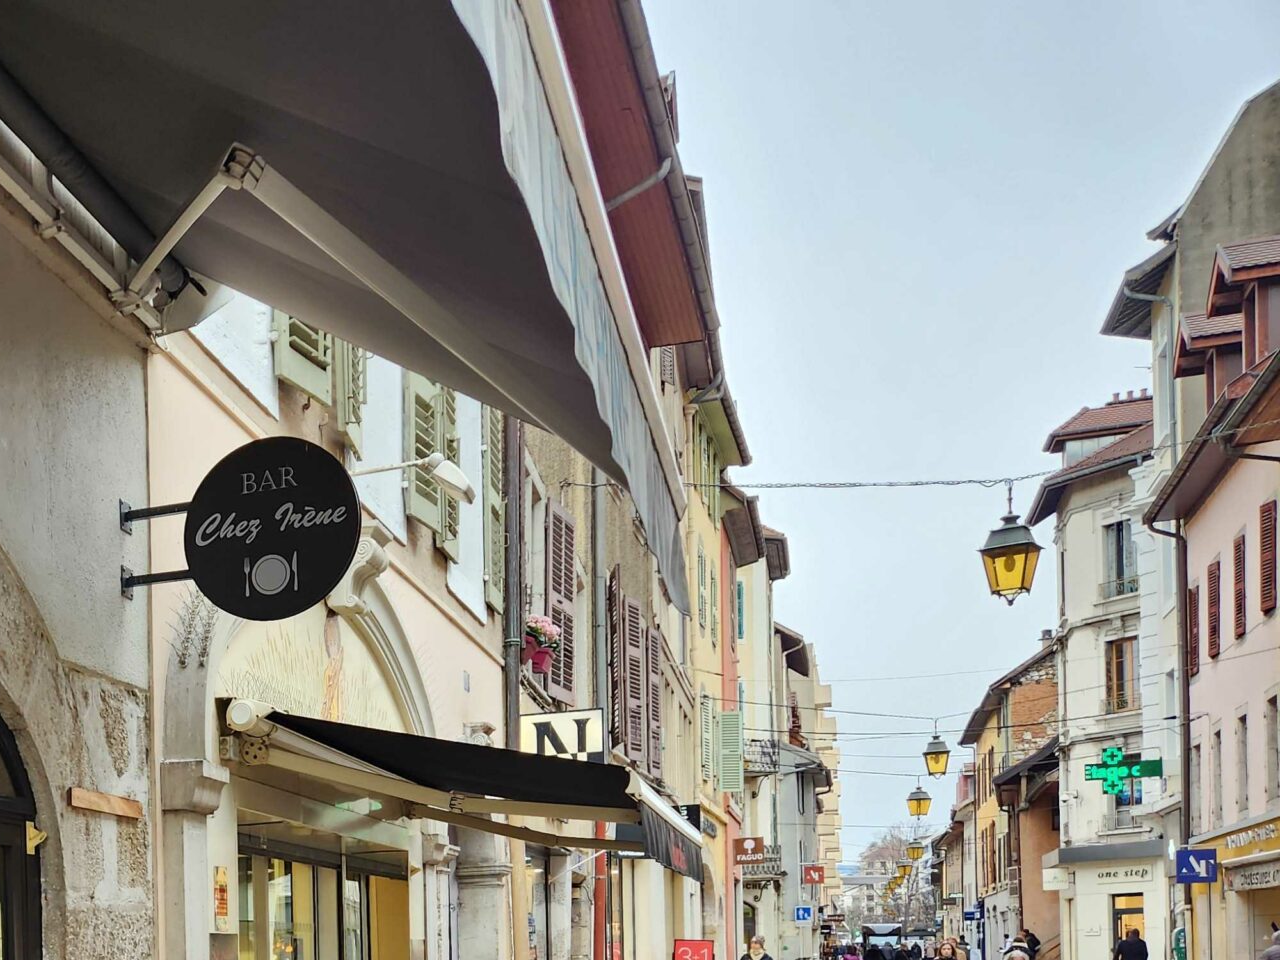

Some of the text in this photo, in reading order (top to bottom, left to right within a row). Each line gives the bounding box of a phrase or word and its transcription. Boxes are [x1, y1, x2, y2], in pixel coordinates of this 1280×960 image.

[240, 466, 298, 495] BAR
[195, 502, 348, 547] Chez Irène
[736, 853, 763, 861] FAGUO
[1097, 868, 1149, 880] one step
